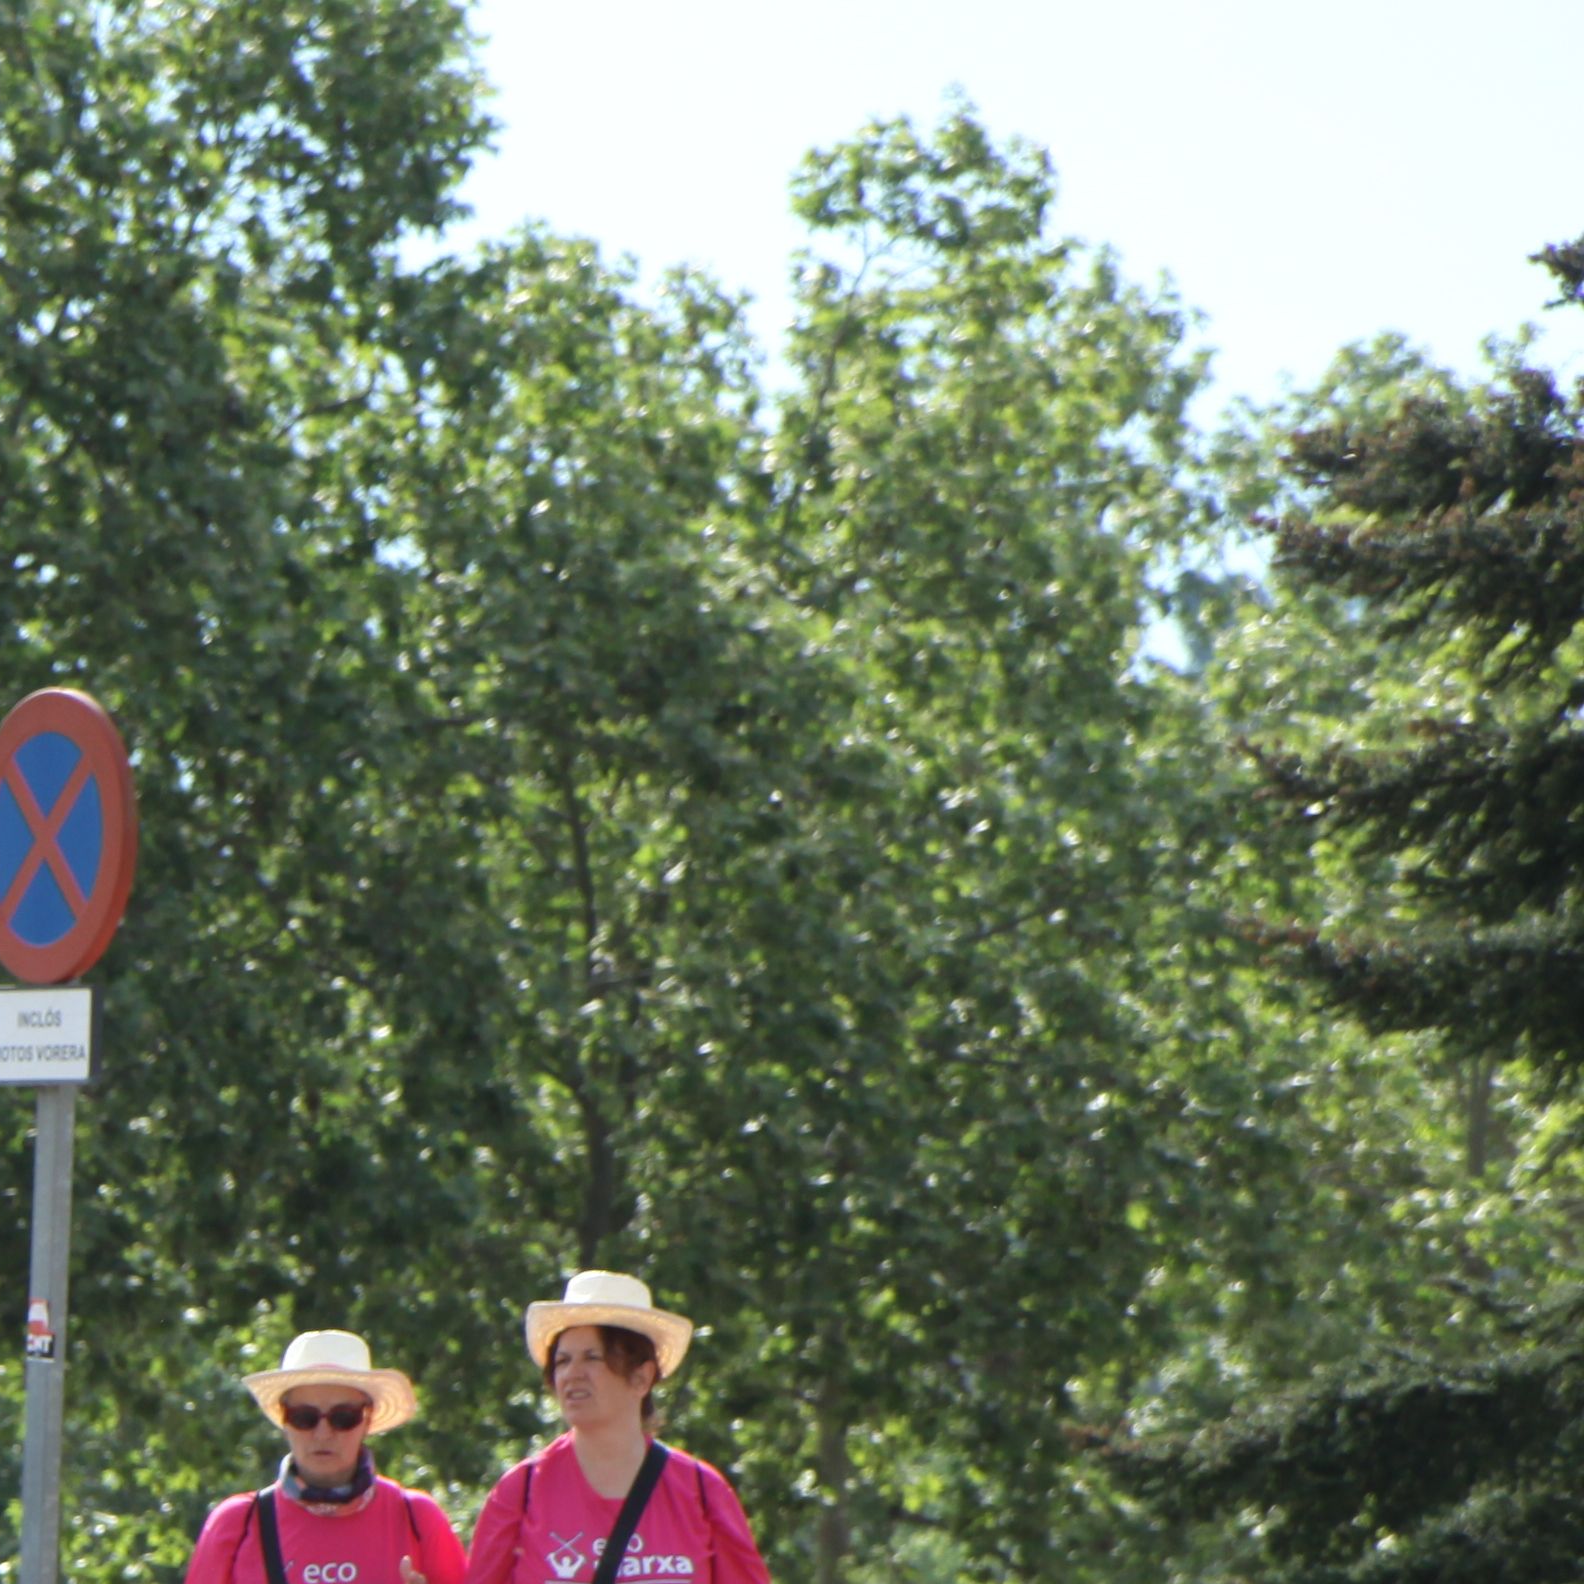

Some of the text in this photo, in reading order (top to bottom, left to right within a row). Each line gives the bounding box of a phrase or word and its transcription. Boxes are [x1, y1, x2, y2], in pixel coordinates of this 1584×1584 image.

[17, 1006, 62, 1029] INCLÓS
[36, 1044, 86, 1060] VORERA
[592, 1533, 644, 1555] eo
[303, 1562, 357, 1584] eco
